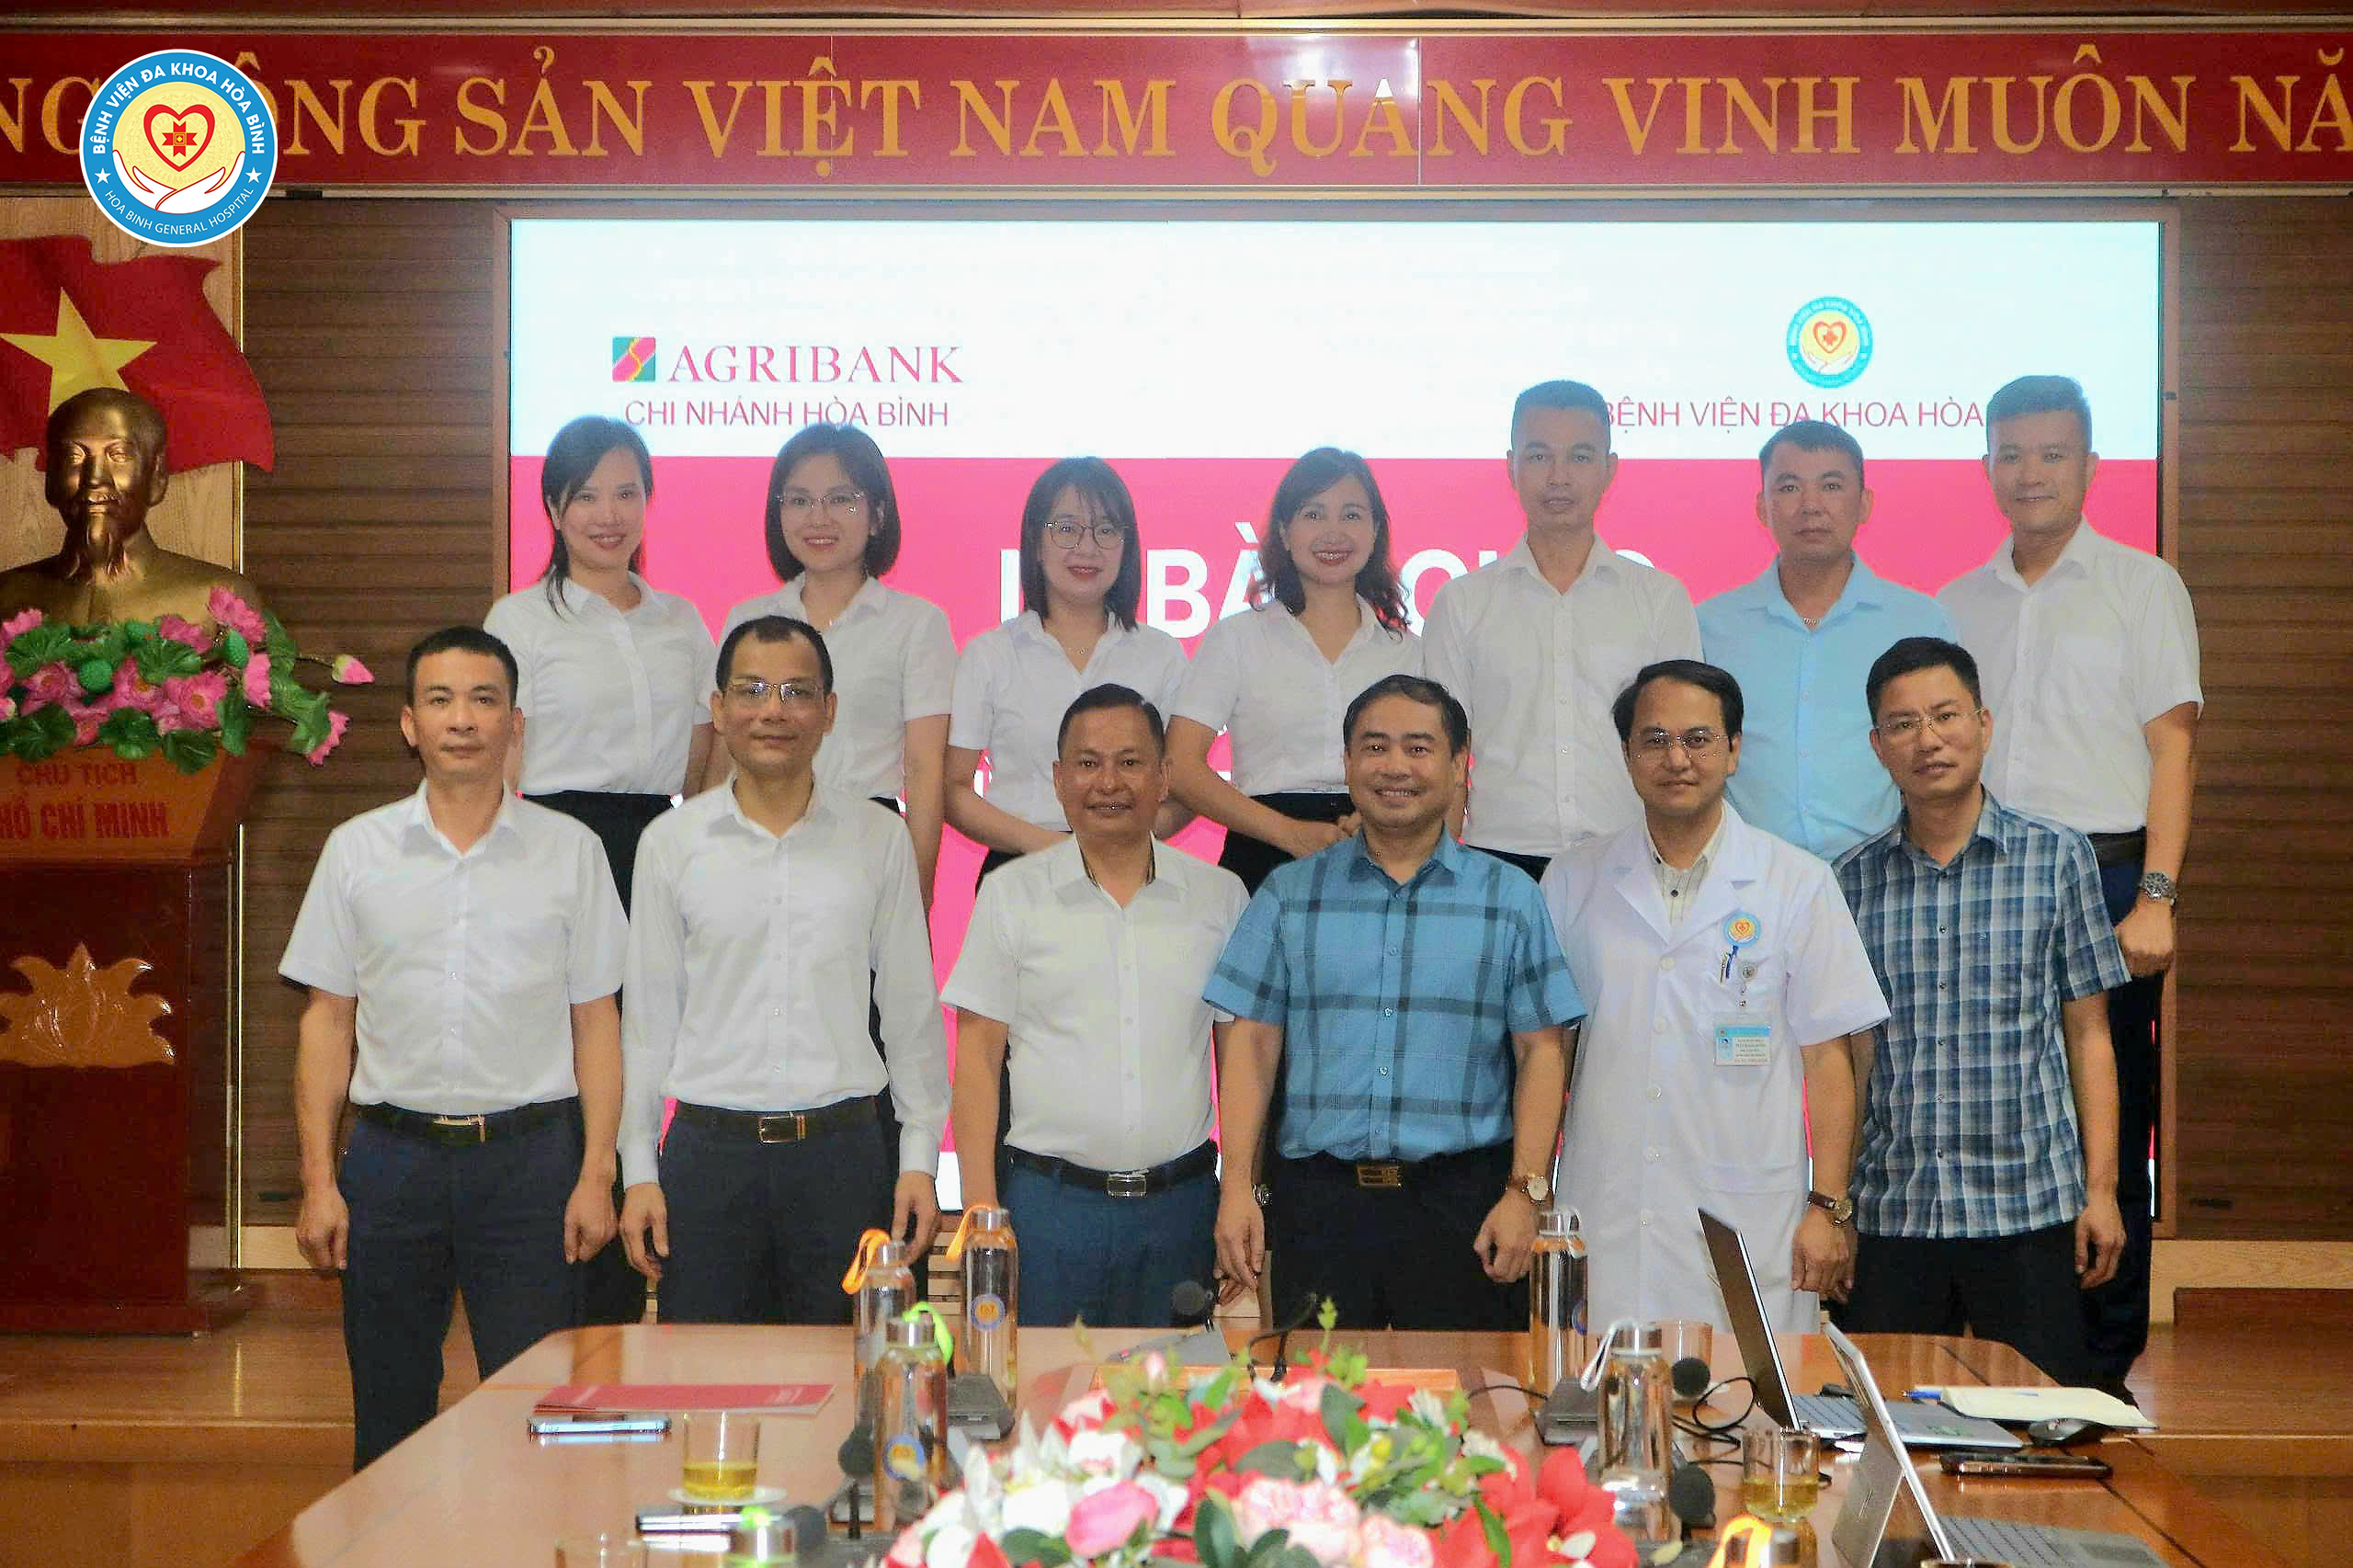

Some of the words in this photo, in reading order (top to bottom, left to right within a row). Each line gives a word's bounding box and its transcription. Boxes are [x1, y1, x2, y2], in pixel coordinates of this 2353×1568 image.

[455, 46, 652, 157] SẢN
[682, 56, 920, 177] VIỆT
[949, 77, 1176, 157] NAM
[1211, 77, 1573, 177] QUANG
[1602, 75, 1861, 156] VINH
[1894, 44, 2197, 154] MUÔN
[667, 345, 964, 383] AGRIBANK
[625, 401, 676, 426] CHI
[687, 395, 792, 426] NHÁNH
[803, 395, 869, 426] HÒA
[877, 396, 949, 426] BÌNH
[1689, 396, 1760, 434] VIỆN
[1822, 402, 1909, 427] KHOA
[1918, 395, 1985, 427] HÒA
[93, 800, 171, 838] MINH
